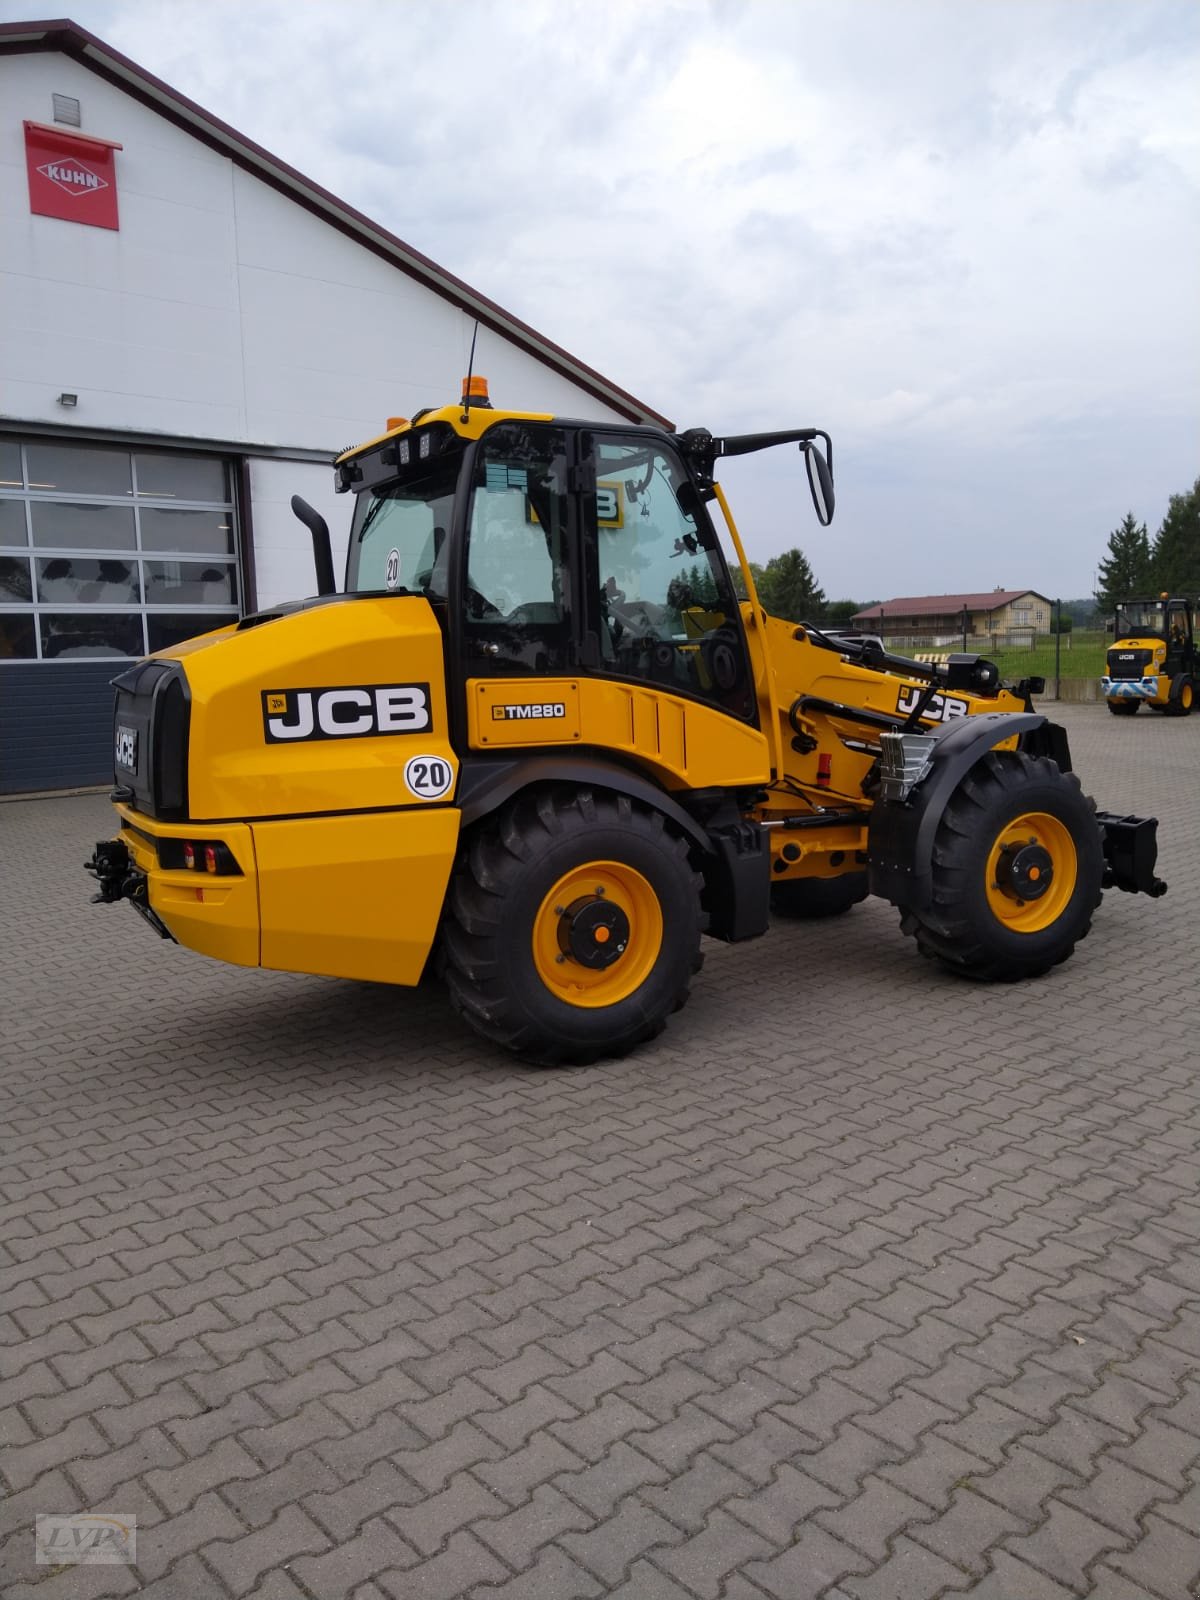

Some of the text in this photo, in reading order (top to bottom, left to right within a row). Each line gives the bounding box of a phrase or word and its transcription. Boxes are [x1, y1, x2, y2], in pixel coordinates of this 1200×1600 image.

[47, 165, 98, 188] KUHN
[387, 558, 398, 581] 20
[268, 687, 429, 739] JCB
[505, 703, 564, 719] TM280
[116, 731, 134, 767] JCB
[413, 762, 445, 788] 20
